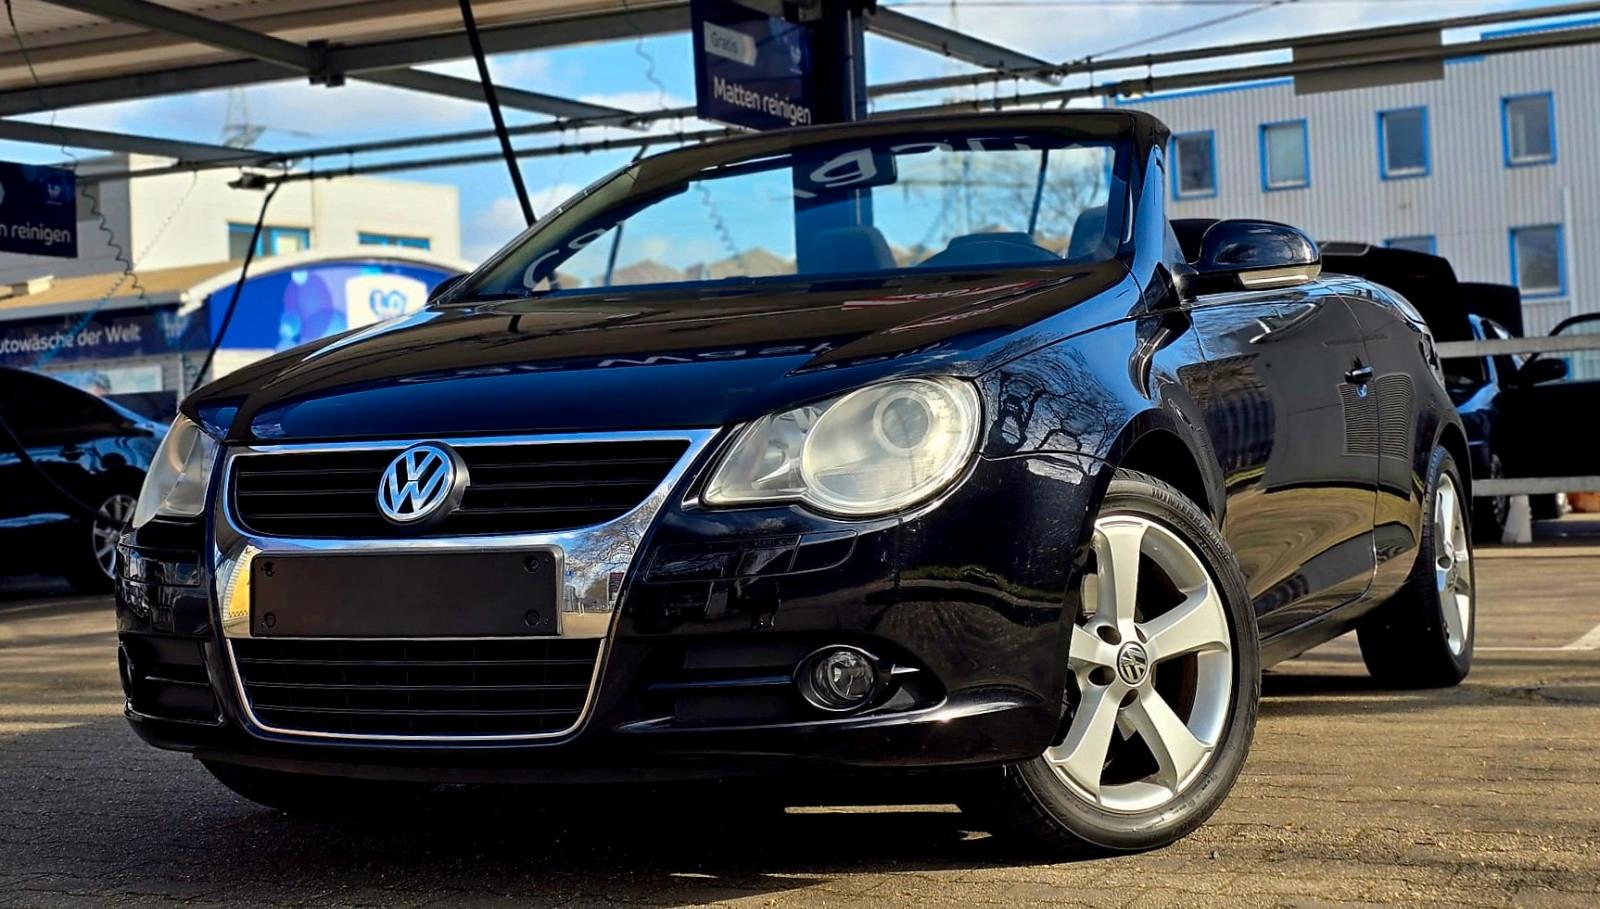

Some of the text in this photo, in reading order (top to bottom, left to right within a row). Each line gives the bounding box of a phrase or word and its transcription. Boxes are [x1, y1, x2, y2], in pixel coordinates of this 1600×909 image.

[713, 76, 812, 127] Matten reinigen
[11, 221, 71, 246] reinigen
[77, 327, 102, 346] der
[105, 323, 142, 344] Welt
